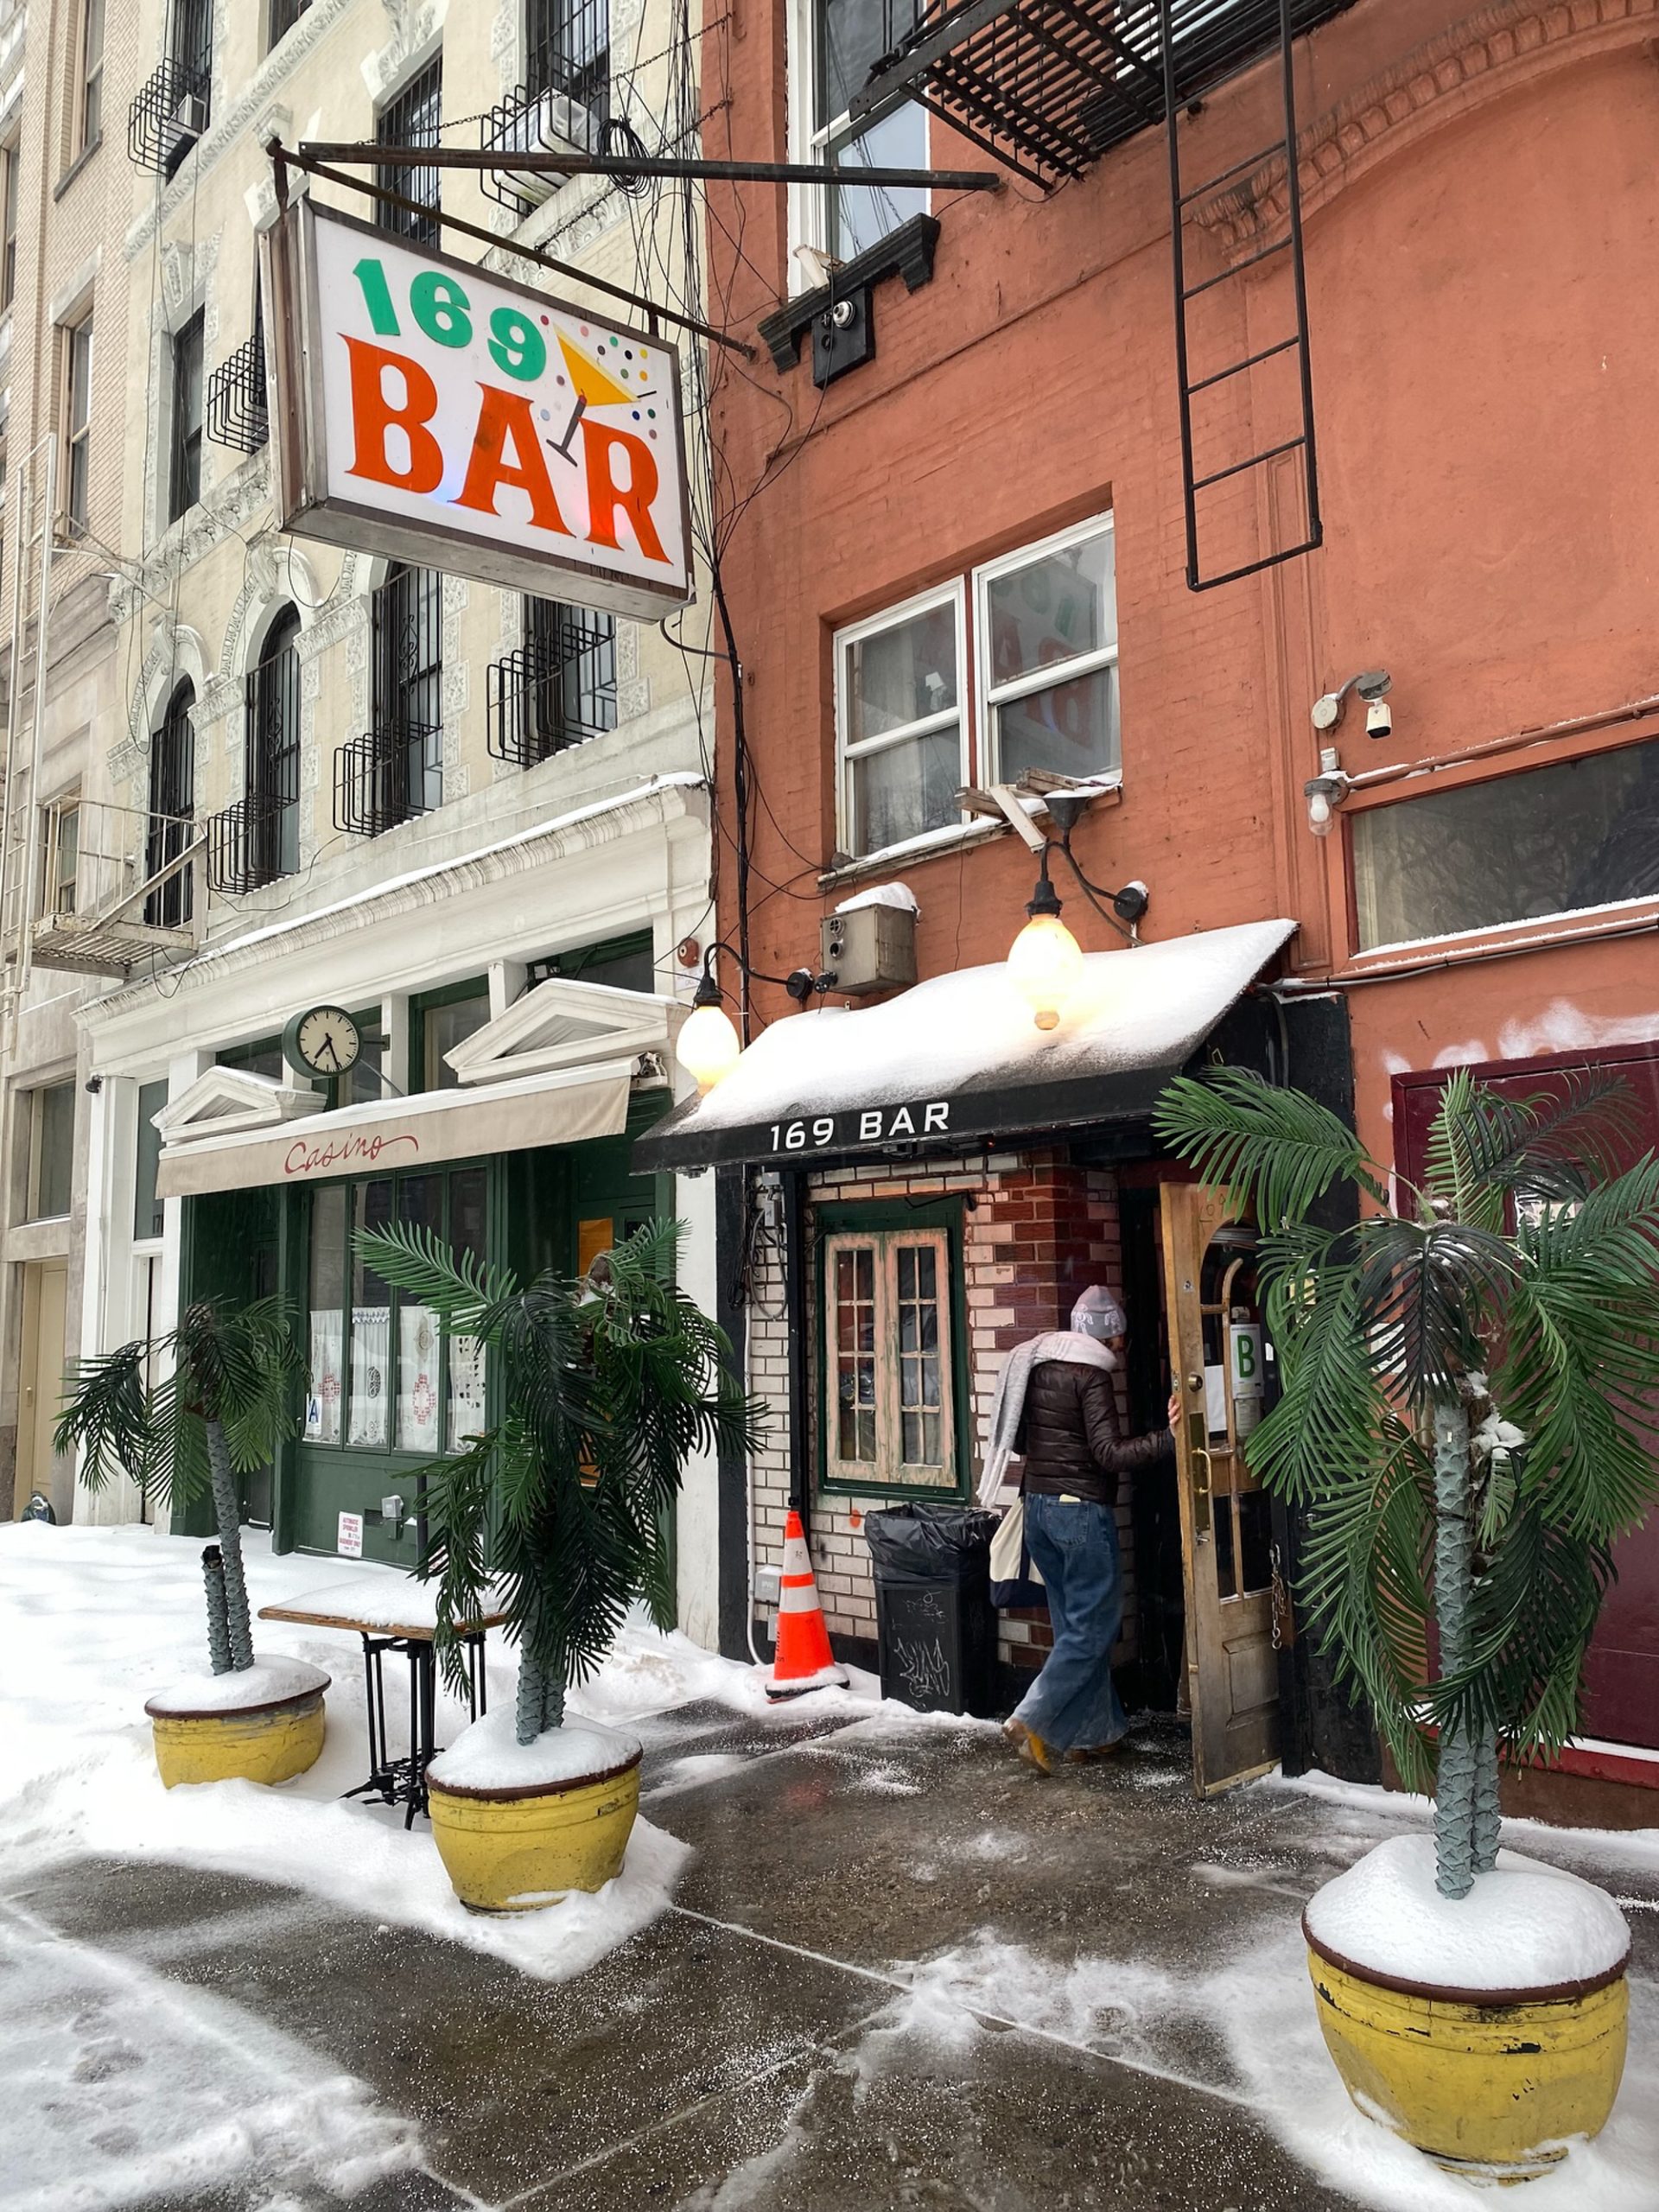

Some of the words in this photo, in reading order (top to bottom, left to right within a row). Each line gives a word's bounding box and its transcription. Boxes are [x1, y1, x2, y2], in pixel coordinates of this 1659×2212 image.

[353, 258, 546, 382] 169
[337, 332, 674, 566] BAR
[770, 1118, 835, 1152] 169
[859, 1102, 950, 1141] BAR
[284, 1133, 419, 1174] Casino
[1236, 1334, 1256, 1378] B
[308, 1399, 319, 1424] A
